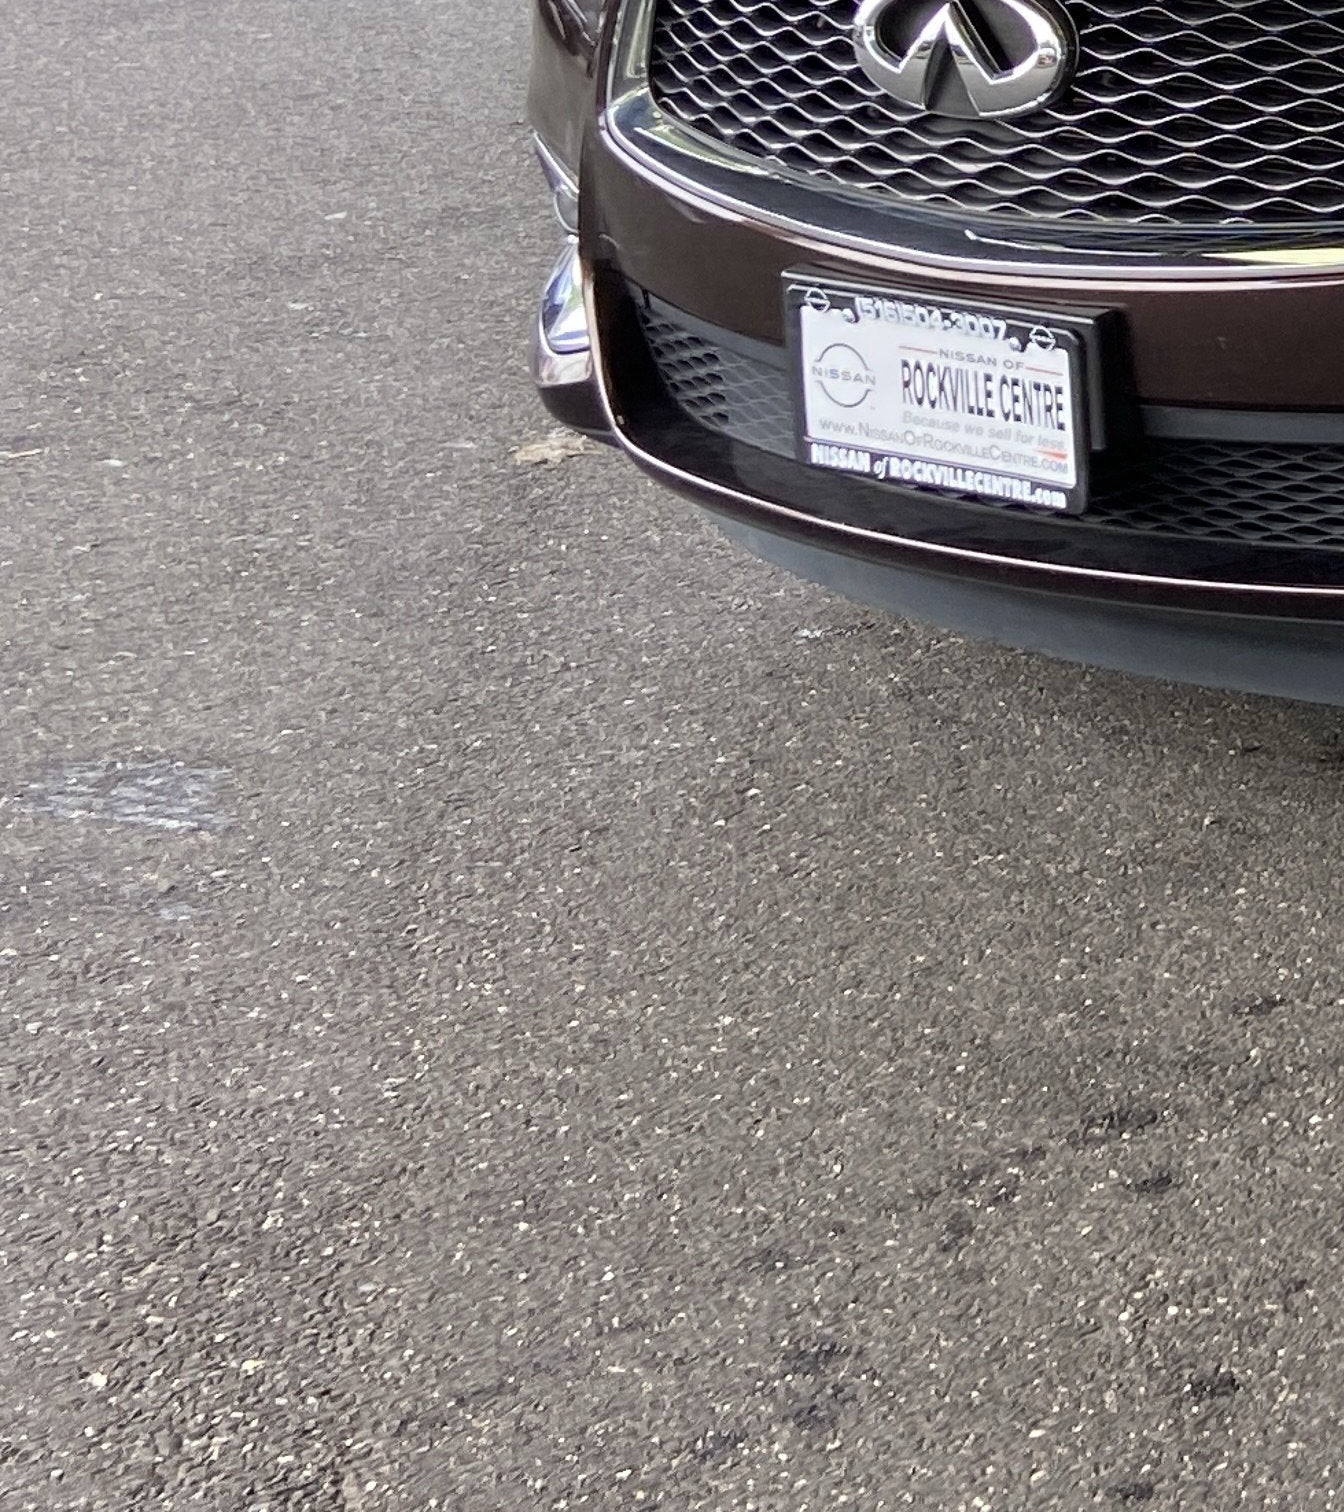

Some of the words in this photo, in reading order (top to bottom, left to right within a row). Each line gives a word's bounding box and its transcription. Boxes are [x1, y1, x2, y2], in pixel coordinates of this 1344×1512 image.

[812, 366, 876, 386] NISSAN
[939, 348, 997, 367] NISSAN
[1003, 359, 1024, 371] OF
[900, 359, 995, 418] ROCKVILLE
[1000, 374, 1066, 431] CENTRE
[902, 410, 960, 432] Because
[964, 423, 984, 436] we
[988, 427, 1012, 441] sell
[1015, 429, 1035, 444] for
[811, 443, 870, 473] NISSAN
[873, 456, 889, 480] of
